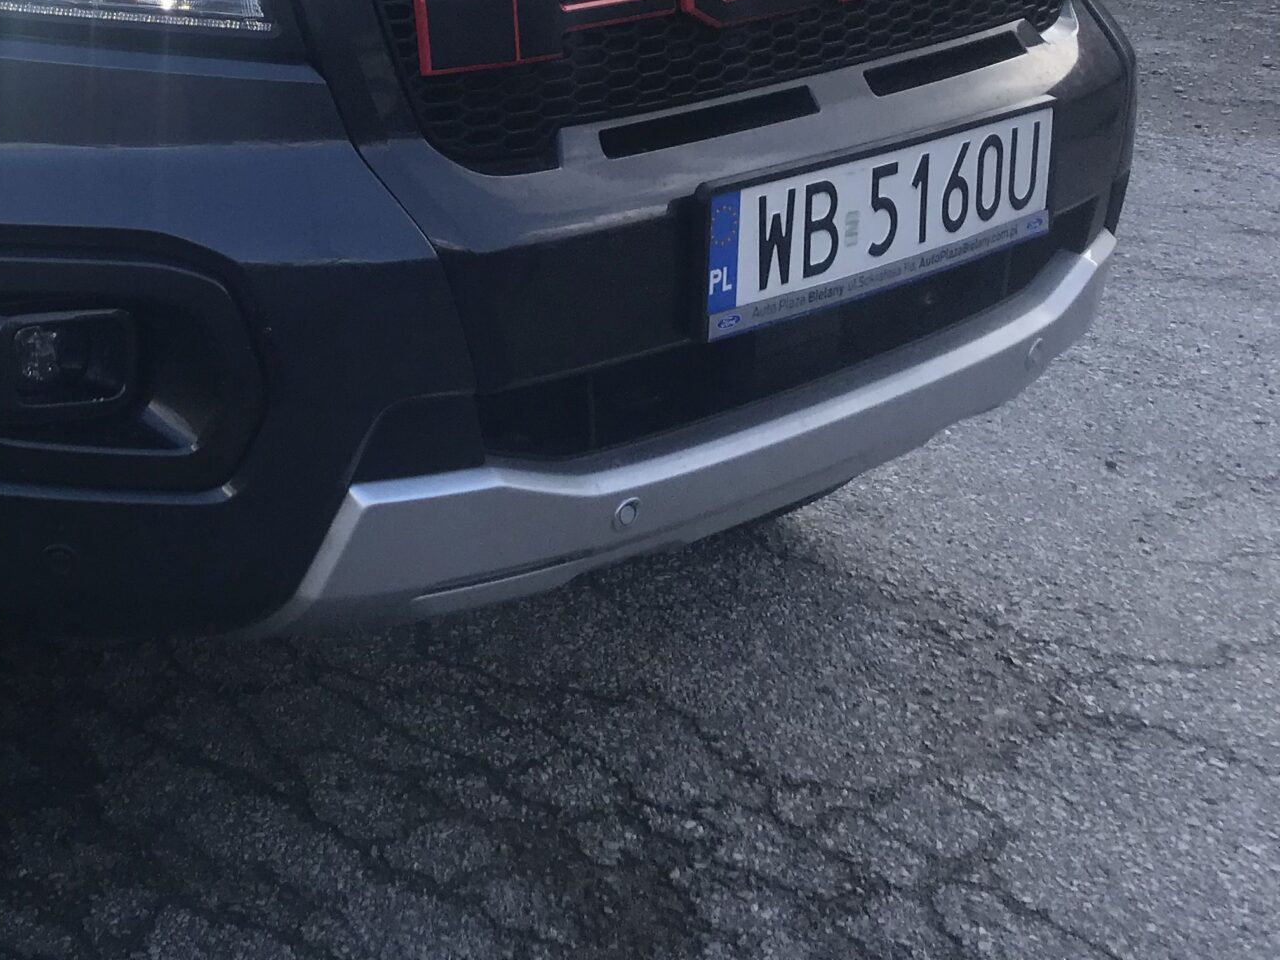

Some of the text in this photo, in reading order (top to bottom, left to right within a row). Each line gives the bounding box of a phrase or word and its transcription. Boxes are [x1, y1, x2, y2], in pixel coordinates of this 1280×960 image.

[758, 121, 1041, 291] WB 5160U
[708, 266, 732, 296] PL
[752, 304, 776, 319] Auto
[778, 297, 806, 313] Plaza
